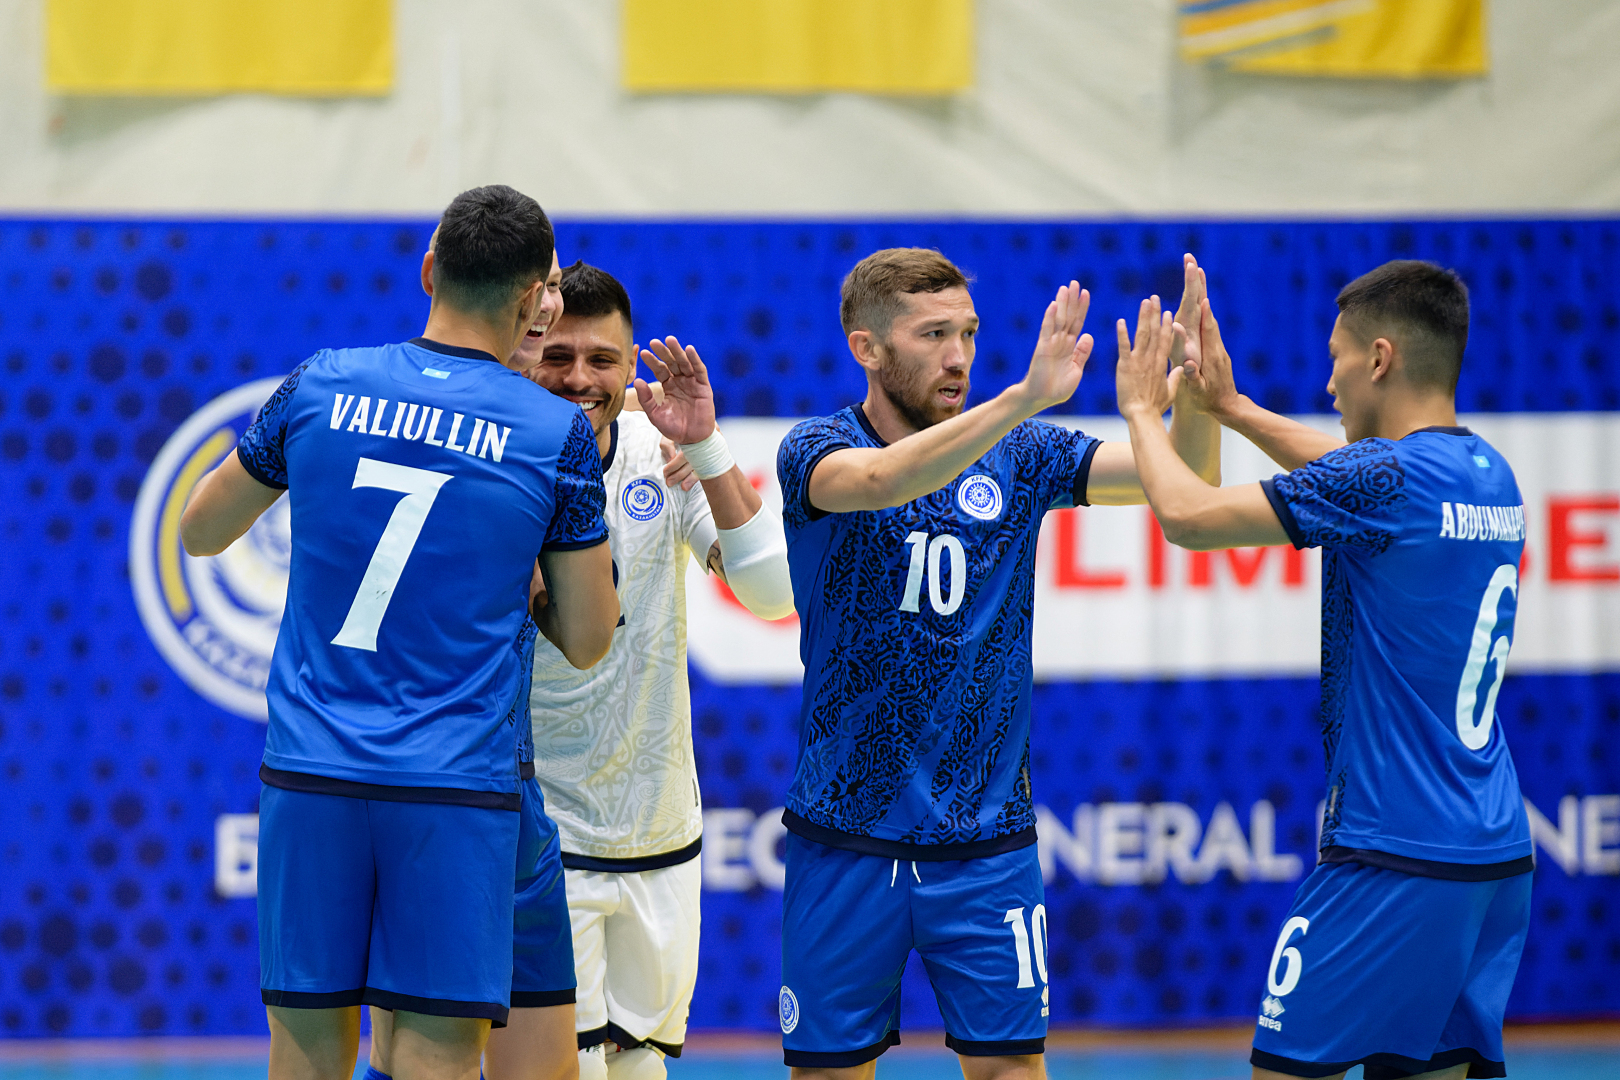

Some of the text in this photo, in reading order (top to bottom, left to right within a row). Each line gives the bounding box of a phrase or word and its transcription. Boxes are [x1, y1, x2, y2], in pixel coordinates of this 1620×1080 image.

[330, 393, 511, 463] VALIULLIN
[330, 457, 454, 652] 7
[1439, 502, 1525, 541] ABDUMANAP
[898, 530, 967, 616] 10
[1456, 564, 1518, 750] 6
[1034, 800, 1303, 886] NERAL
[1003, 903, 1048, 989] 10
[1268, 916, 1310, 996] 6
